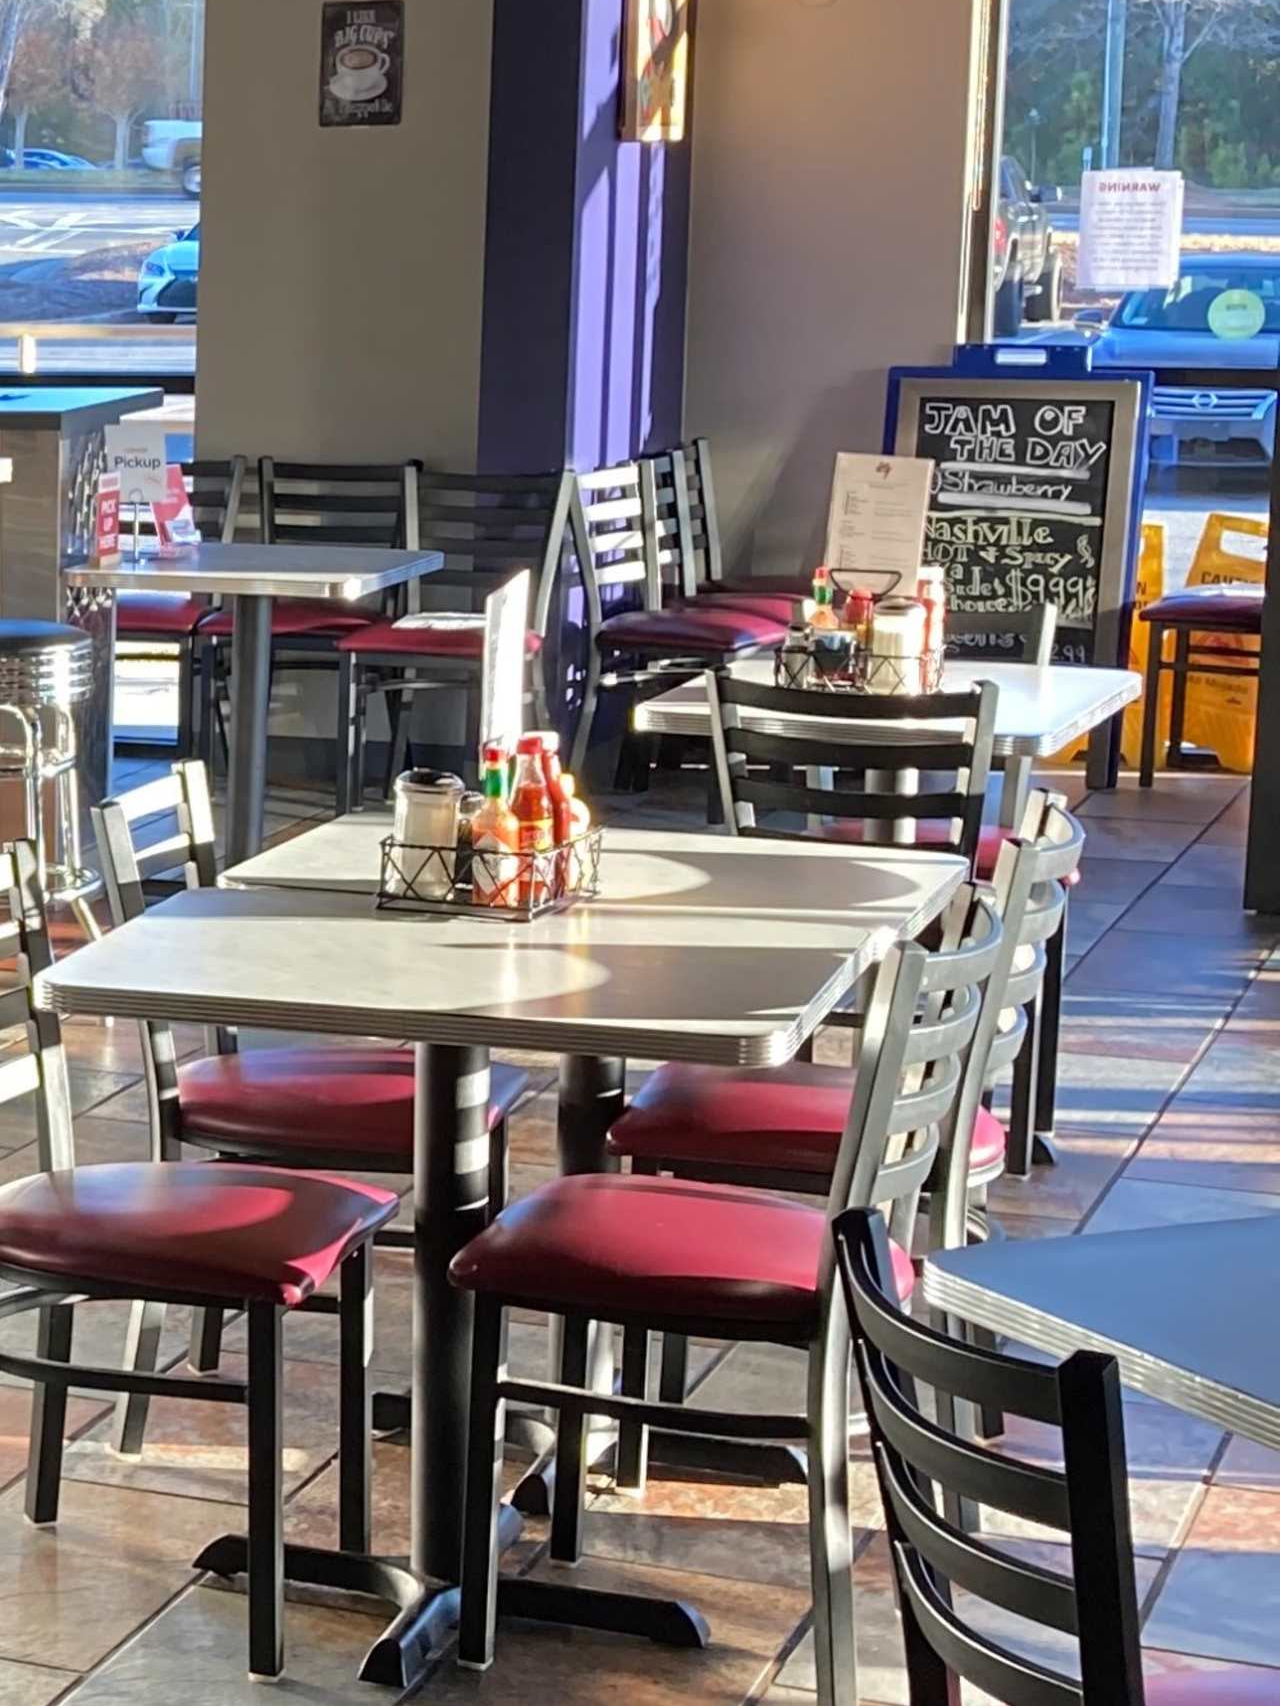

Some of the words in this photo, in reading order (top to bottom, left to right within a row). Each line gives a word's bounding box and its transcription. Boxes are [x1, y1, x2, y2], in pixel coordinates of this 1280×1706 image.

[924, 402, 1016, 437] JAM
[1034, 405, 1087, 436] OF
[114, 455, 161, 470] Pickup
[950, 436, 1016, 462] THE
[1025, 437, 1107, 470] DAY
[941, 470, 1073, 502] Strawberry
[946, 595, 1008, 613] hoice
